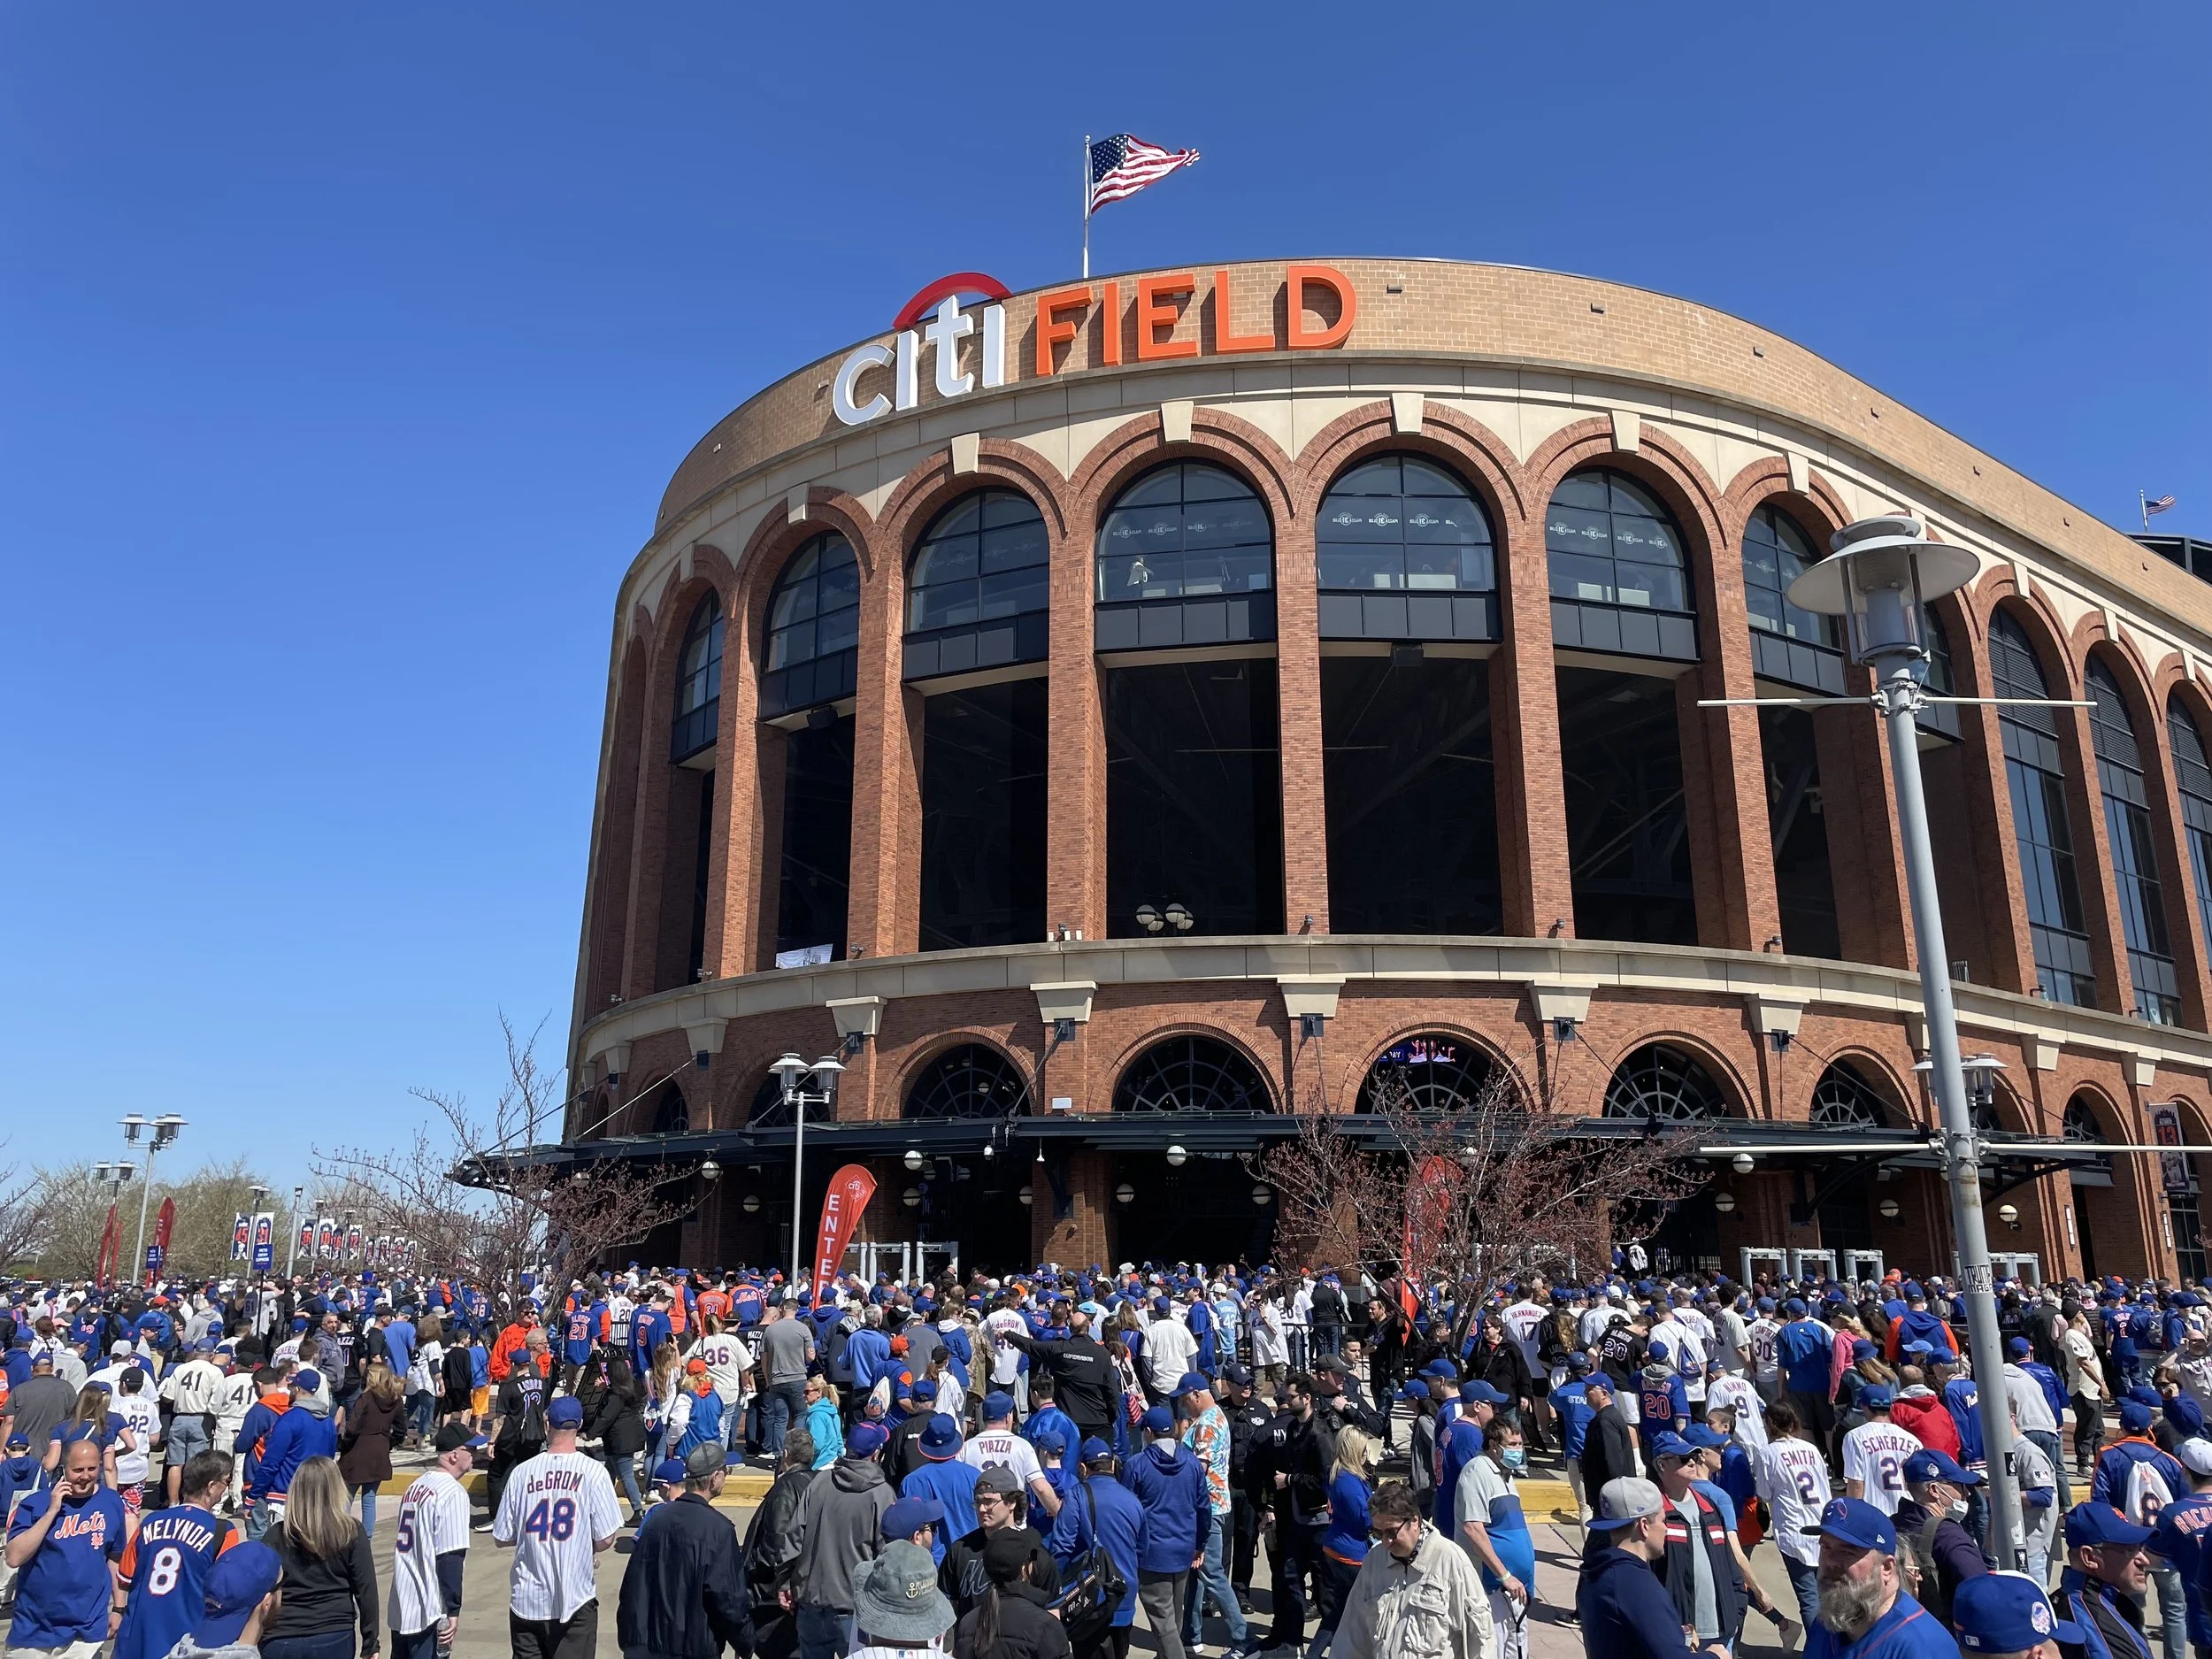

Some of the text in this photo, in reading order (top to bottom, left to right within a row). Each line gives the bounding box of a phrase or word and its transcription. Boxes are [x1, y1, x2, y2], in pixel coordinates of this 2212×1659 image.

[833, 265, 1357, 425] citi FIELD
[234, 1227, 249, 1244] 45
[619, 1309, 631, 1323] 20
[995, 1318, 1020, 1329] deGROM
[1510, 1309, 1542, 1318] HERNANDEZ
[337, 1335, 355, 1346] AZZA
[569, 1324, 588, 1340] 20
[636, 1325, 648, 1347] 9
[1519, 1321, 1537, 1343] 17
[1755, 1325, 1777, 1343] CONFORT
[275, 1344, 299, 1356] SCHERZE
[704, 1345, 730, 1367] 36
[1063, 1352, 1094, 1363] SUPERVISOR
[1602, 1337, 1628, 1362] 20
[1755, 1337, 1772, 1363] 30
[180, 1371, 204, 1392] 41
[1722, 1381, 1747, 1393] NIMMO
[230, 1384, 254, 1405] 41
[1567, 1394, 1587, 1405] STA
[1643, 1393, 1671, 1420] 20
[1734, 1394, 1750, 1419] 9
[128, 1414, 150, 1434] 82
[1273, 1428, 1287, 1442] NY
[978, 1439, 1012, 1455] PIAZZA
[1780, 1449, 1816, 1468] SMITH
[526, 1470, 584, 1495] deGROM
[1879, 1455, 1907, 1491] 2
[1795, 1471, 1821, 1505] 2
[54, 1510, 106, 1540] Mets
[526, 1497, 577, 1543] 48
[142, 1517, 215, 1553] MELYNDA
[396, 1509, 416, 1554] 5
[149, 1546, 182, 1596] 8
